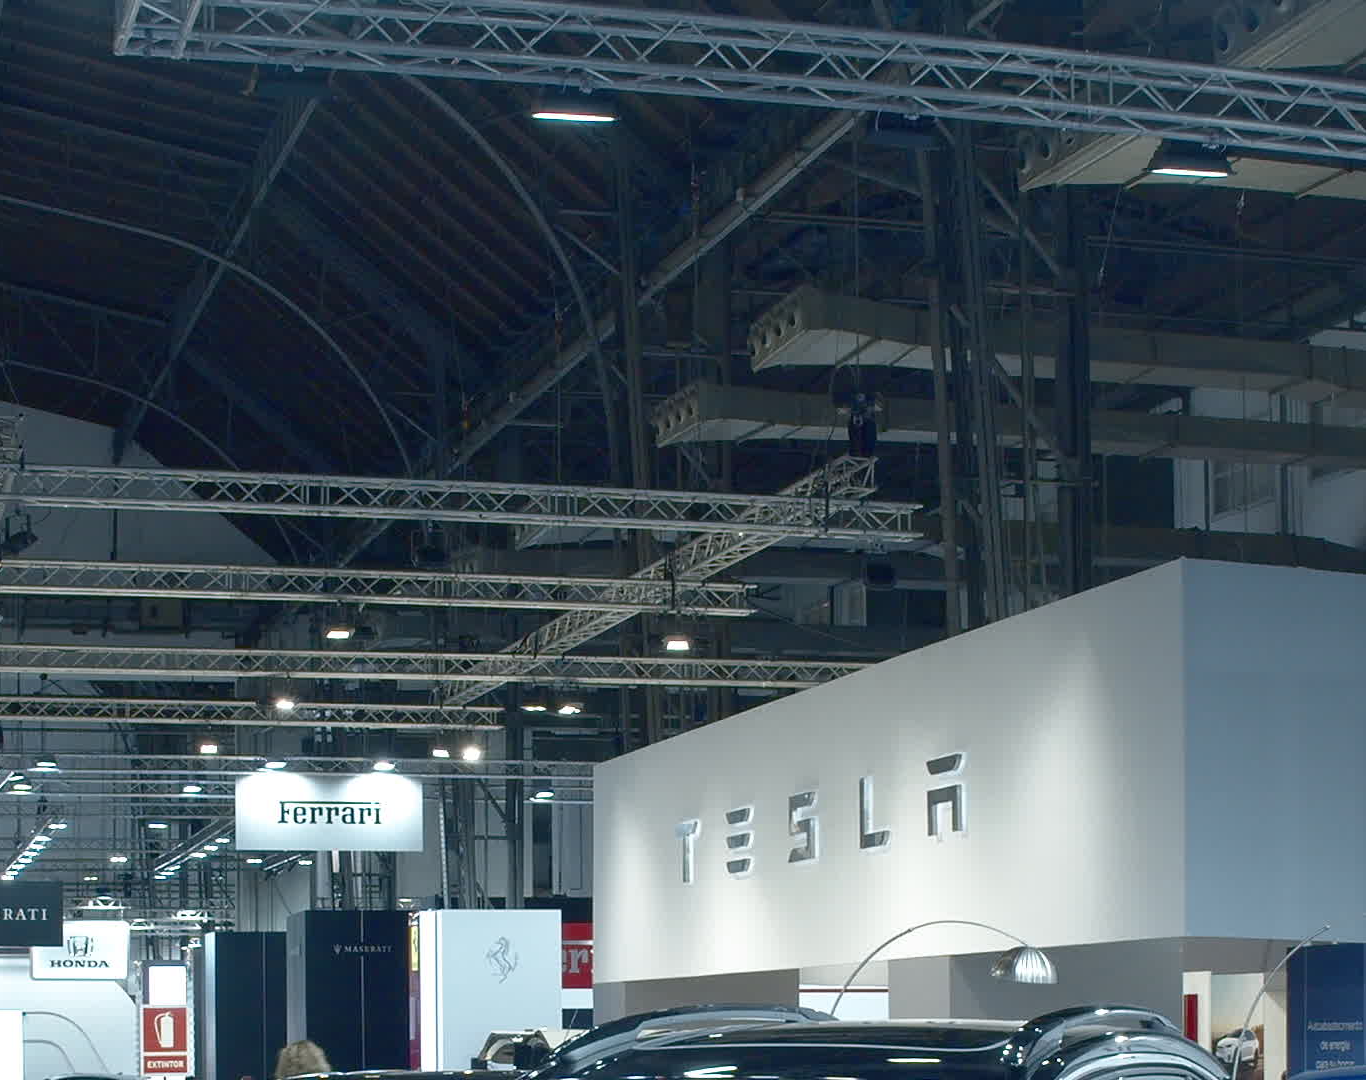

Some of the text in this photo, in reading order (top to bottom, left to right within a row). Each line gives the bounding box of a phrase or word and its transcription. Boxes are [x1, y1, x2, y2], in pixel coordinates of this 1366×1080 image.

[278, 801, 382, 825] Ferrari
[675, 752, 967, 884] TESLA
[50, 959, 110, 969] HONDA
[146, 1060, 185, 1069] EXTINTOR
